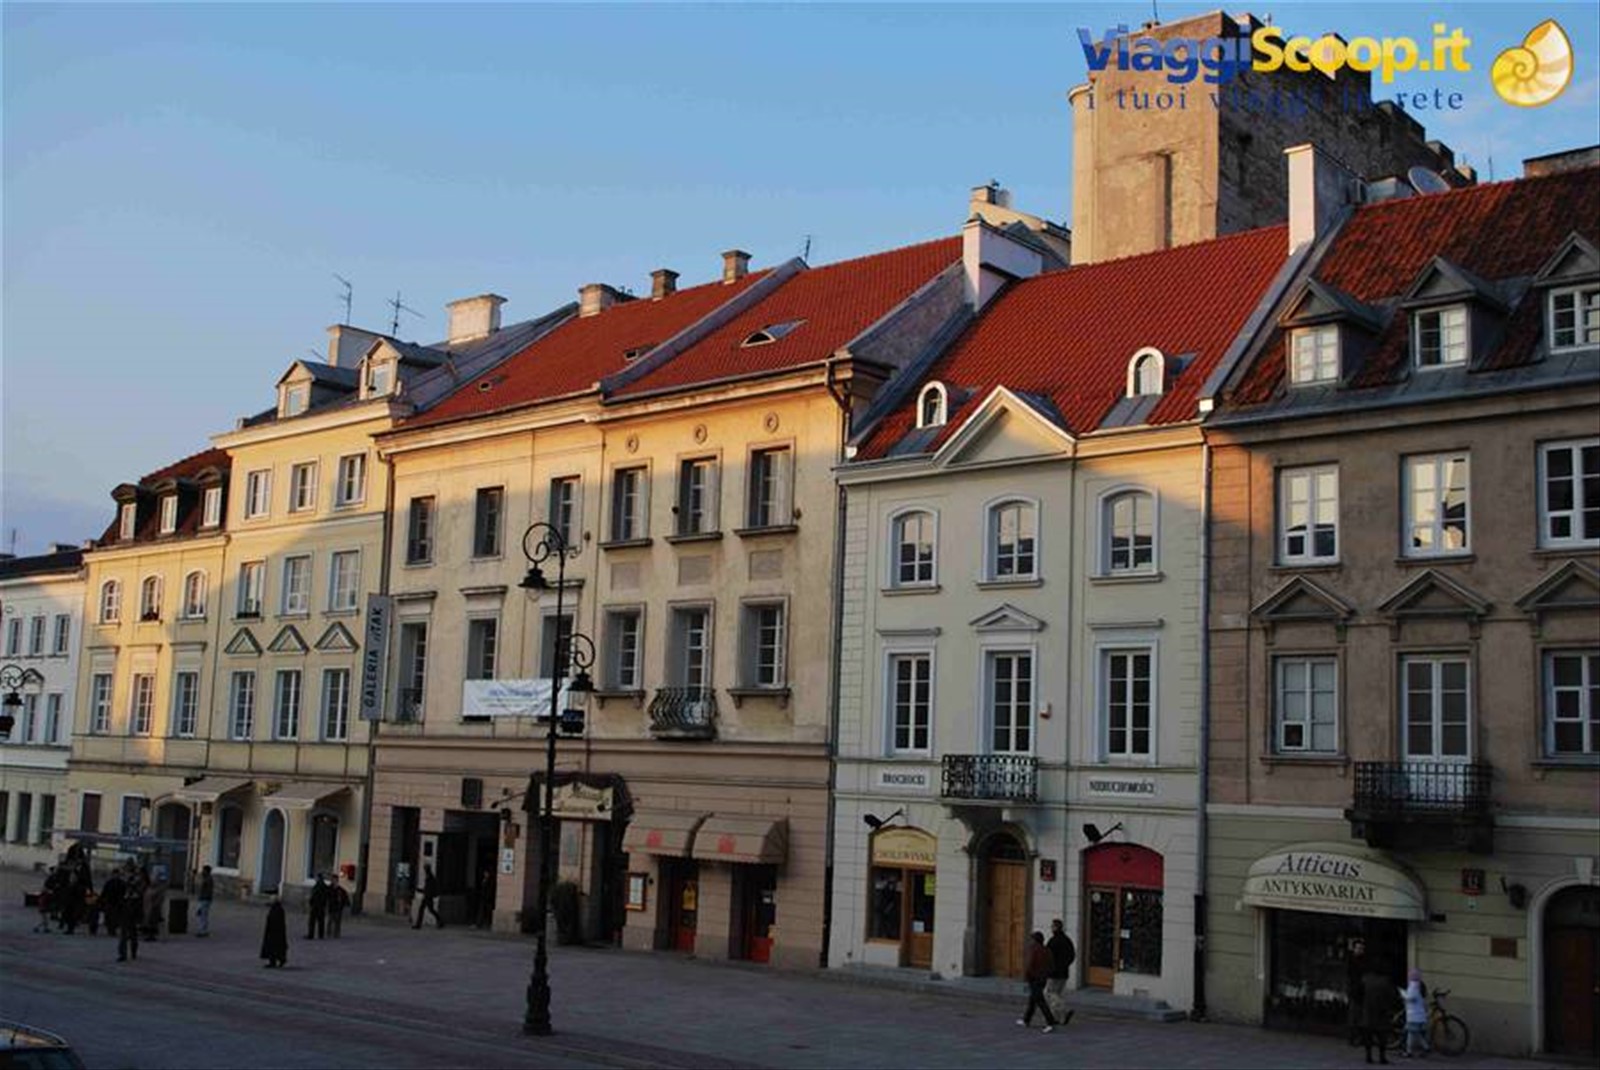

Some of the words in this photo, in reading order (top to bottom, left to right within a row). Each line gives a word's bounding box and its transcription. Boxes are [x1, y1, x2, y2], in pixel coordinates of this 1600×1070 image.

[364, 648, 379, 708] GALERIA
[1277, 853, 1361, 877] Atticus
[1263, 879, 1376, 901] ANTYKWARIAT
